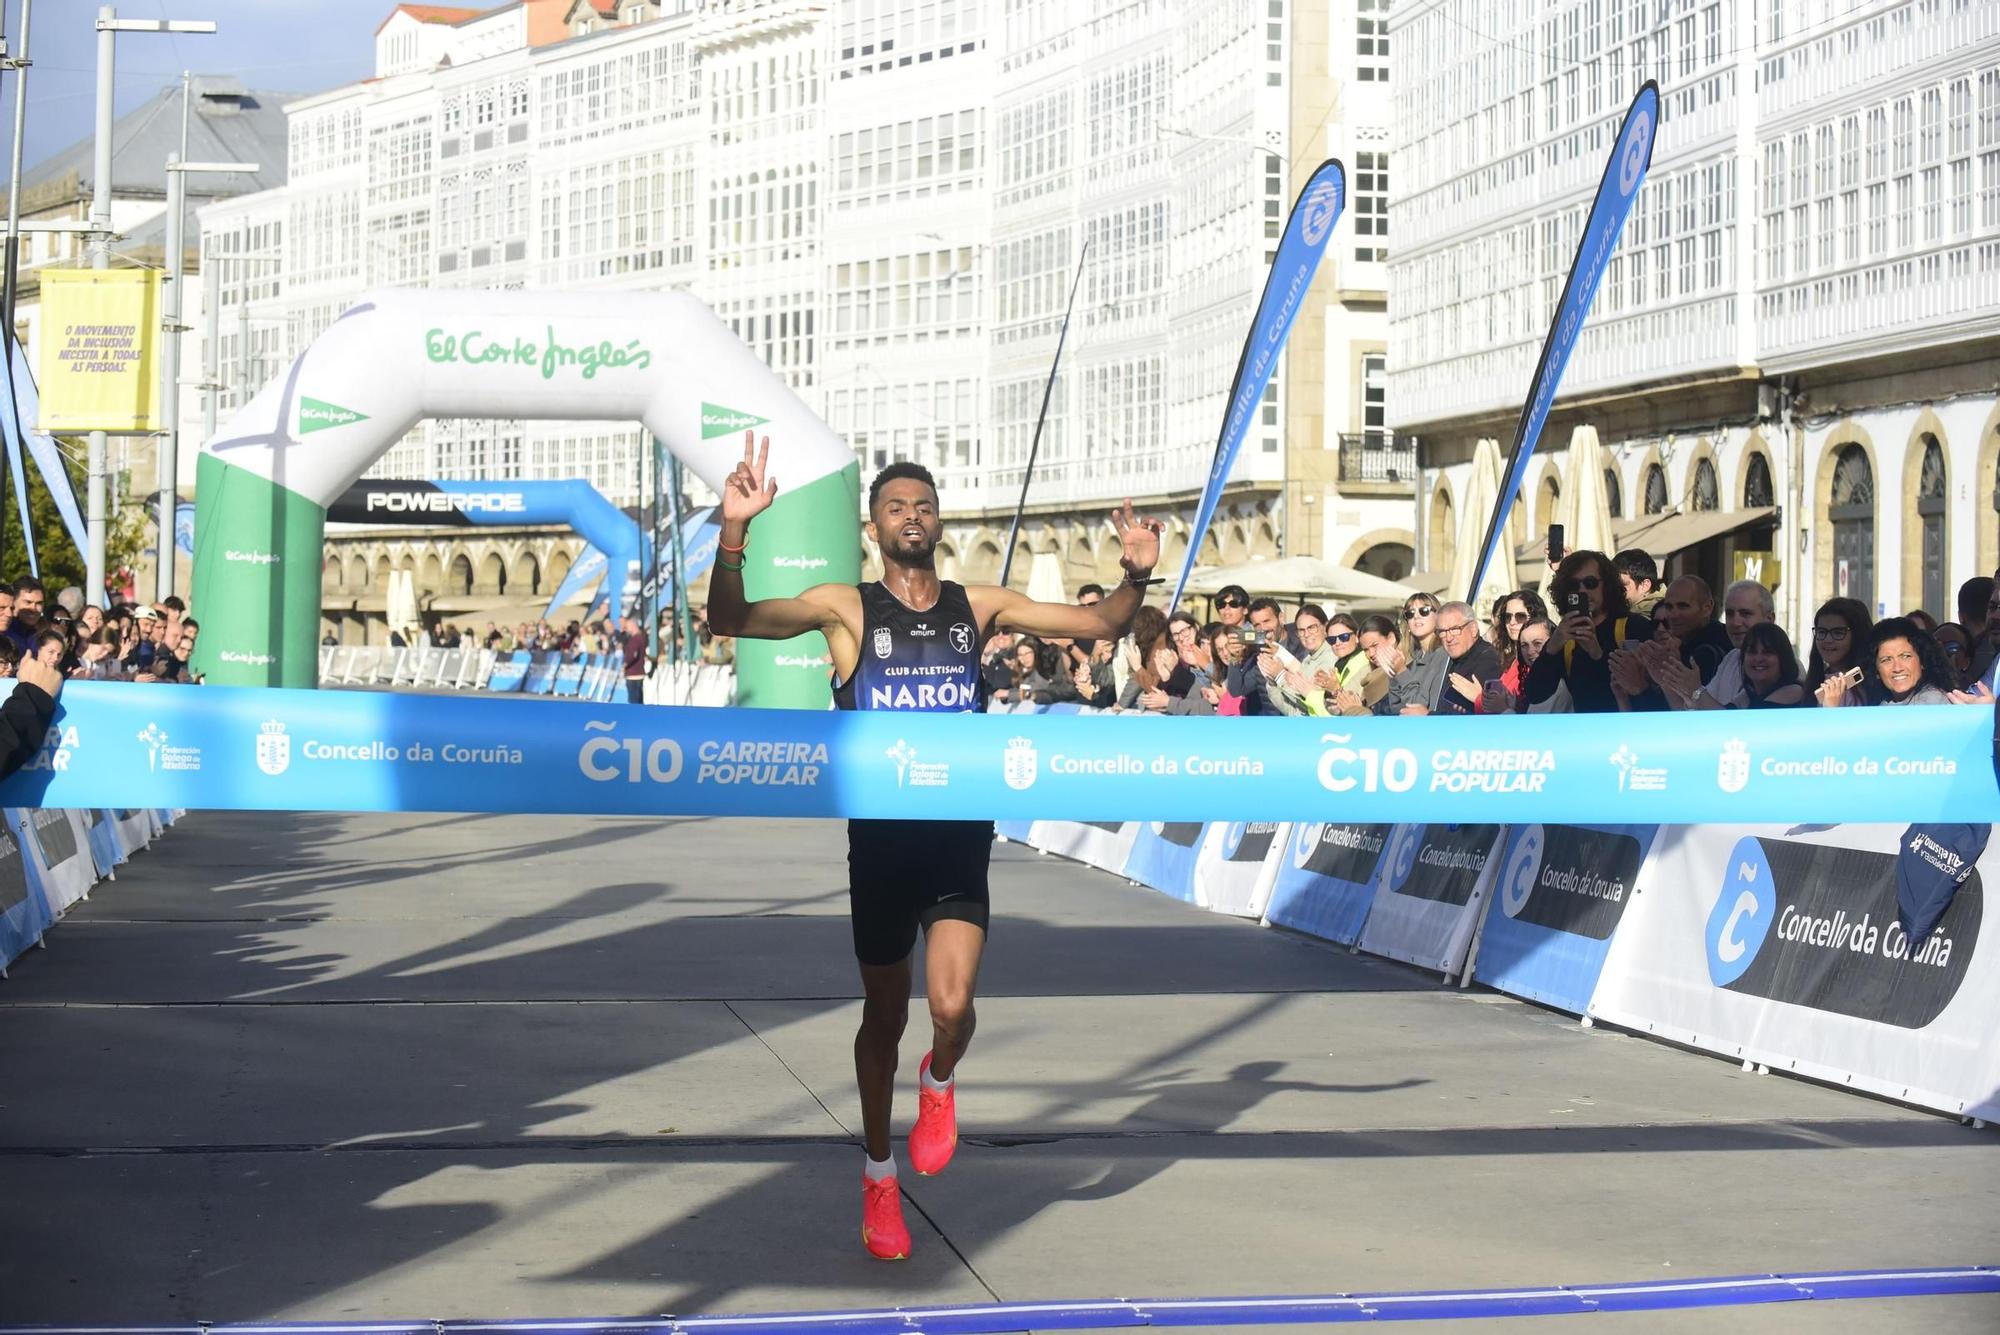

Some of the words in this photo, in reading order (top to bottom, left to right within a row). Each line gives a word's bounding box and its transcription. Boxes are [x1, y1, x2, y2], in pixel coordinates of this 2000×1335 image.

[1562, 310, 1577, 346] da
[1577, 214, 1616, 306] Coruña
[65, 325, 72, 336] O
[74, 325, 136, 337] MOVEMENTO
[1254, 349, 1270, 379] da
[1268, 263, 1308, 344] Coruña
[68, 337, 80, 348] DA
[425, 327, 458, 363] El
[460, 330, 537, 366] Corte
[541, 324, 651, 380] Inglés
[58, 350, 99, 360] NECESITA
[102, 350, 109, 360] A
[113, 350, 143, 360] TODAS
[71, 362, 83, 372] AS
[366, 492, 524, 512] POWERADE
[910, 628, 936, 637] amura
[885, 666, 910, 677] CLUB
[911, 664, 965, 676] ATLETISMO
[871, 676, 976, 710] NARÓN
[303, 739, 400, 763] Concello
[406, 740, 434, 763] da
[441, 741, 523, 764] Coruña
[697, 740, 830, 765] CARREIRA
[1431, 749, 1556, 771] CARREIRA
[696, 763, 820, 786] POPULAR
[1049, 754, 1145, 776] Concello
[1150, 755, 1178, 776] da
[1184, 755, 1264, 777] Coruña
[1760, 756, 1849, 777] Concello
[1853, 756, 1879, 776] da
[1883, 755, 1957, 776] Coruña
[1429, 771, 1544, 793] POPULAR
[1322, 823, 1351, 848] Concello
[1541, 863, 1579, 892] Concello
[1579, 870, 1591, 895] da
[1589, 873, 1623, 902] Coruña
[1777, 904, 1851, 950] Concello
[1849, 913, 1878, 954] da
